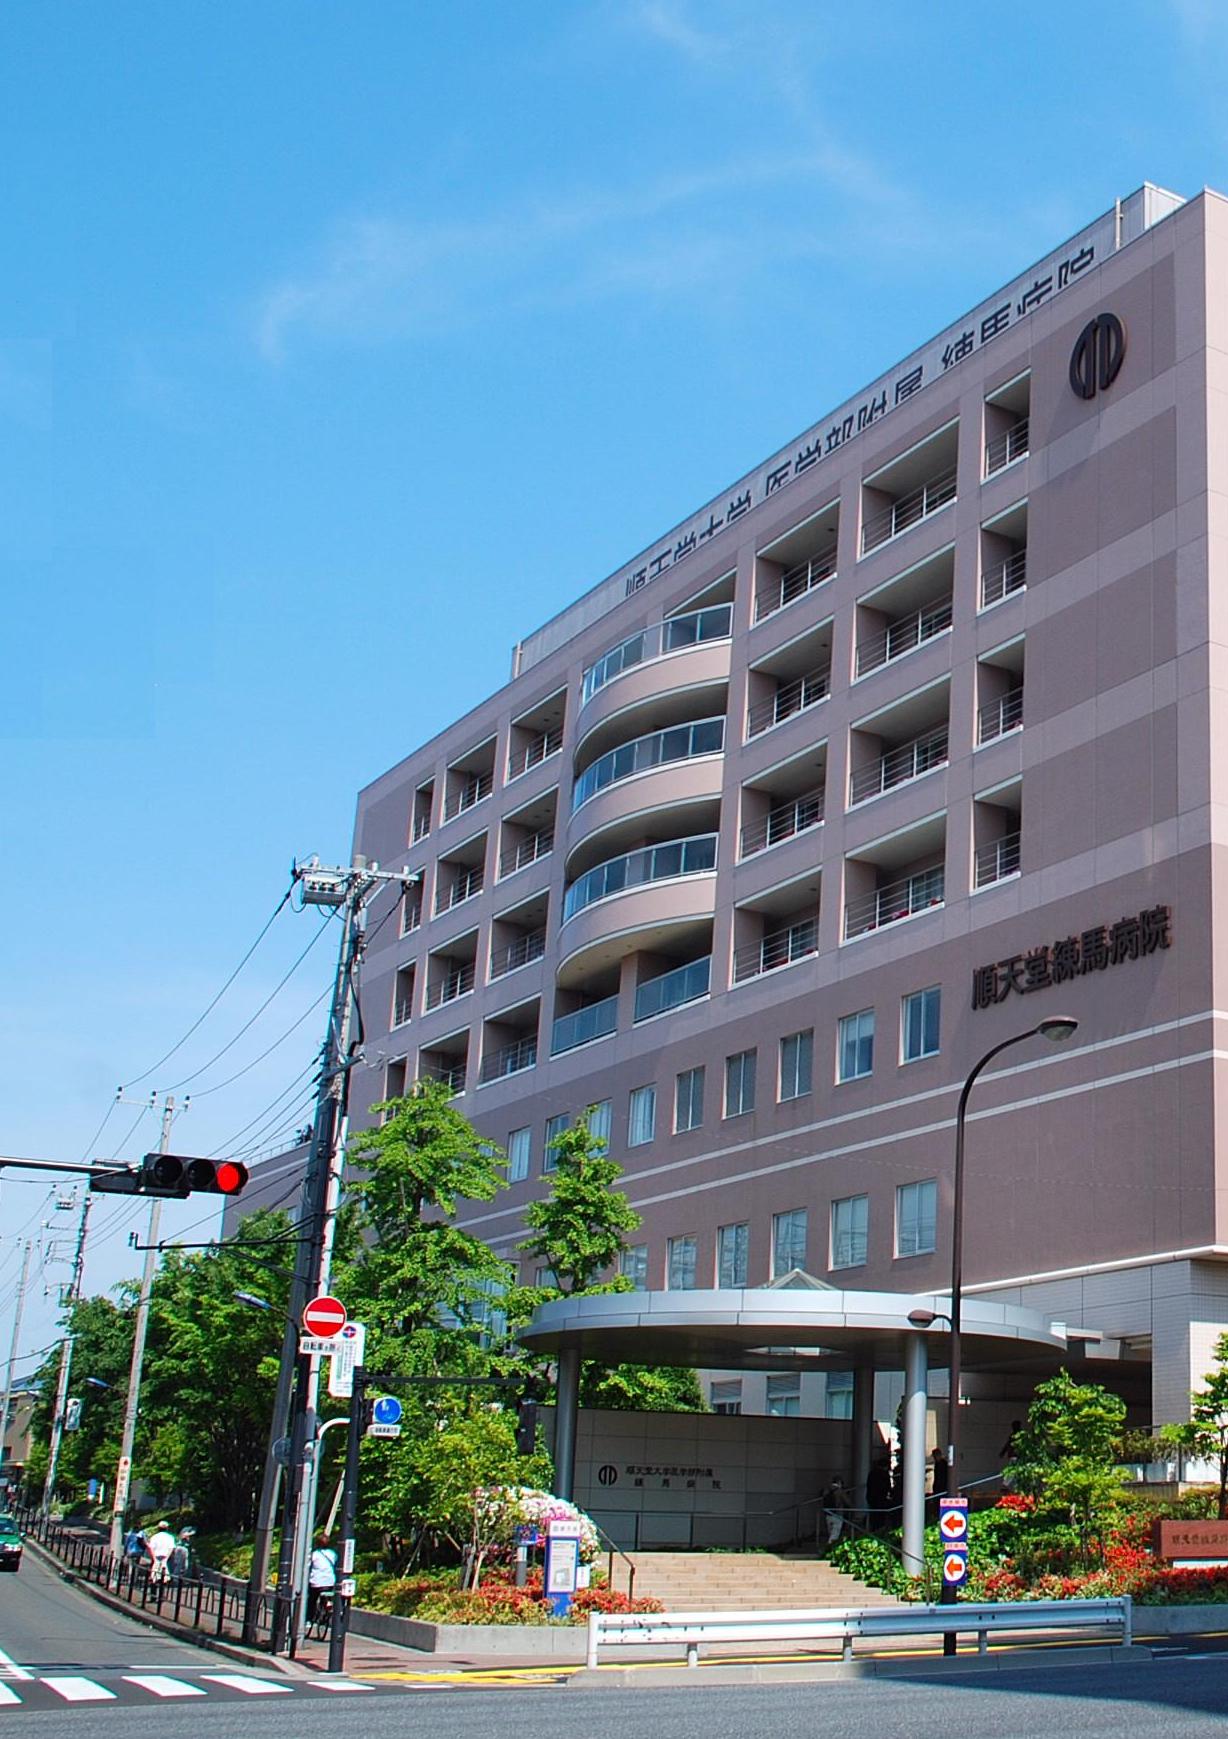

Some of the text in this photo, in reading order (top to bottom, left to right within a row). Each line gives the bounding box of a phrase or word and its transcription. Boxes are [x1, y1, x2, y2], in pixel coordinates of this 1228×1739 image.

[972, 904, 1171, 1010] 順天堂練馬病院
